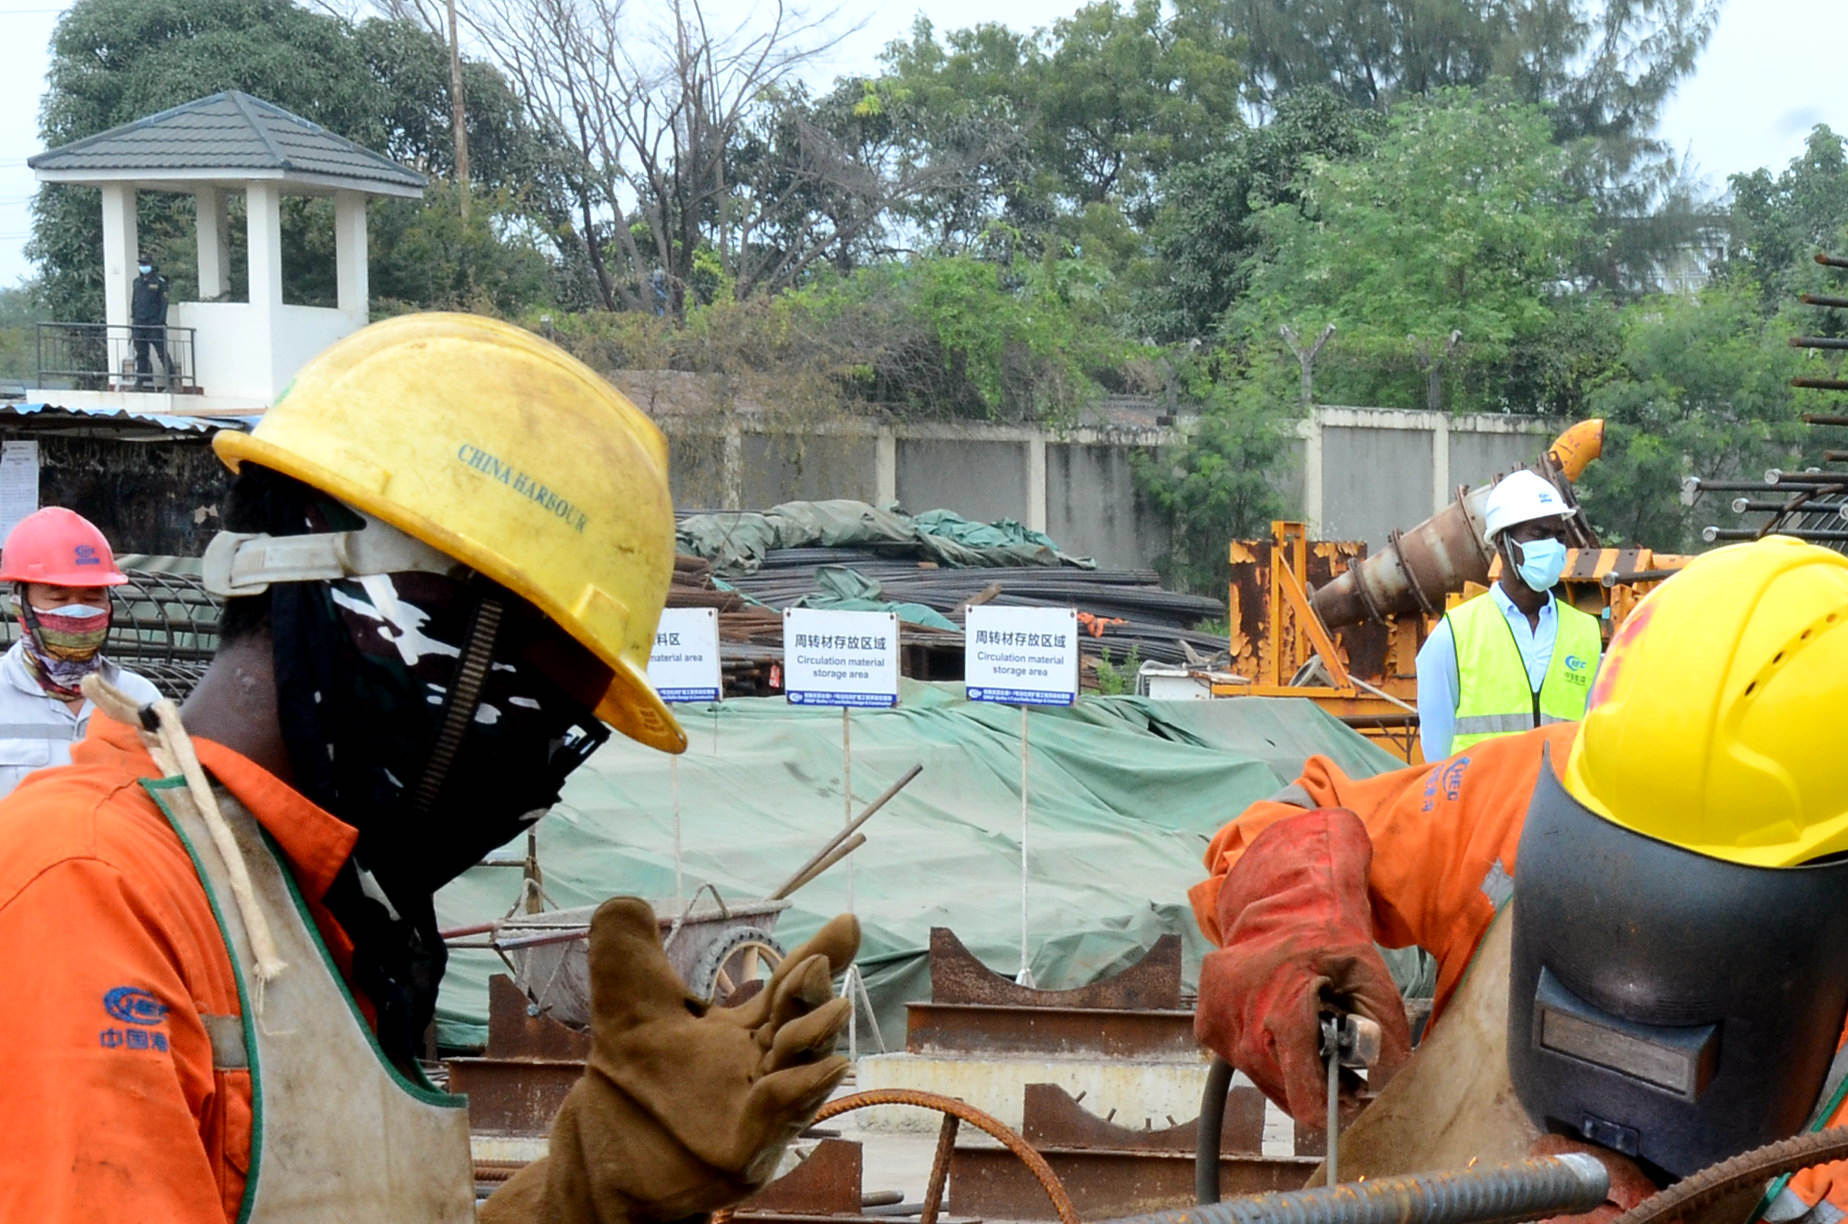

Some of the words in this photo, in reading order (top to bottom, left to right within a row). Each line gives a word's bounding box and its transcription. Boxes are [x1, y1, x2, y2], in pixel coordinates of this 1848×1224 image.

[457, 443, 513, 485] CHINA
[512, 472, 589, 534] HARBOUR
[654, 631, 681, 647] 料区
[795, 633, 887, 650] 周转材存放区域
[975, 630, 1067, 648] 周转材存放区域
[797, 655, 846, 665] Circulation
[848, 658, 885, 667] material
[977, 651, 1026, 663] Circulation
[1028, 655, 1065, 665] material
[813, 669, 847, 680] storage
[849, 671, 869, 679] area
[993, 665, 1027, 677] storage
[1028, 668, 1048, 677] area
